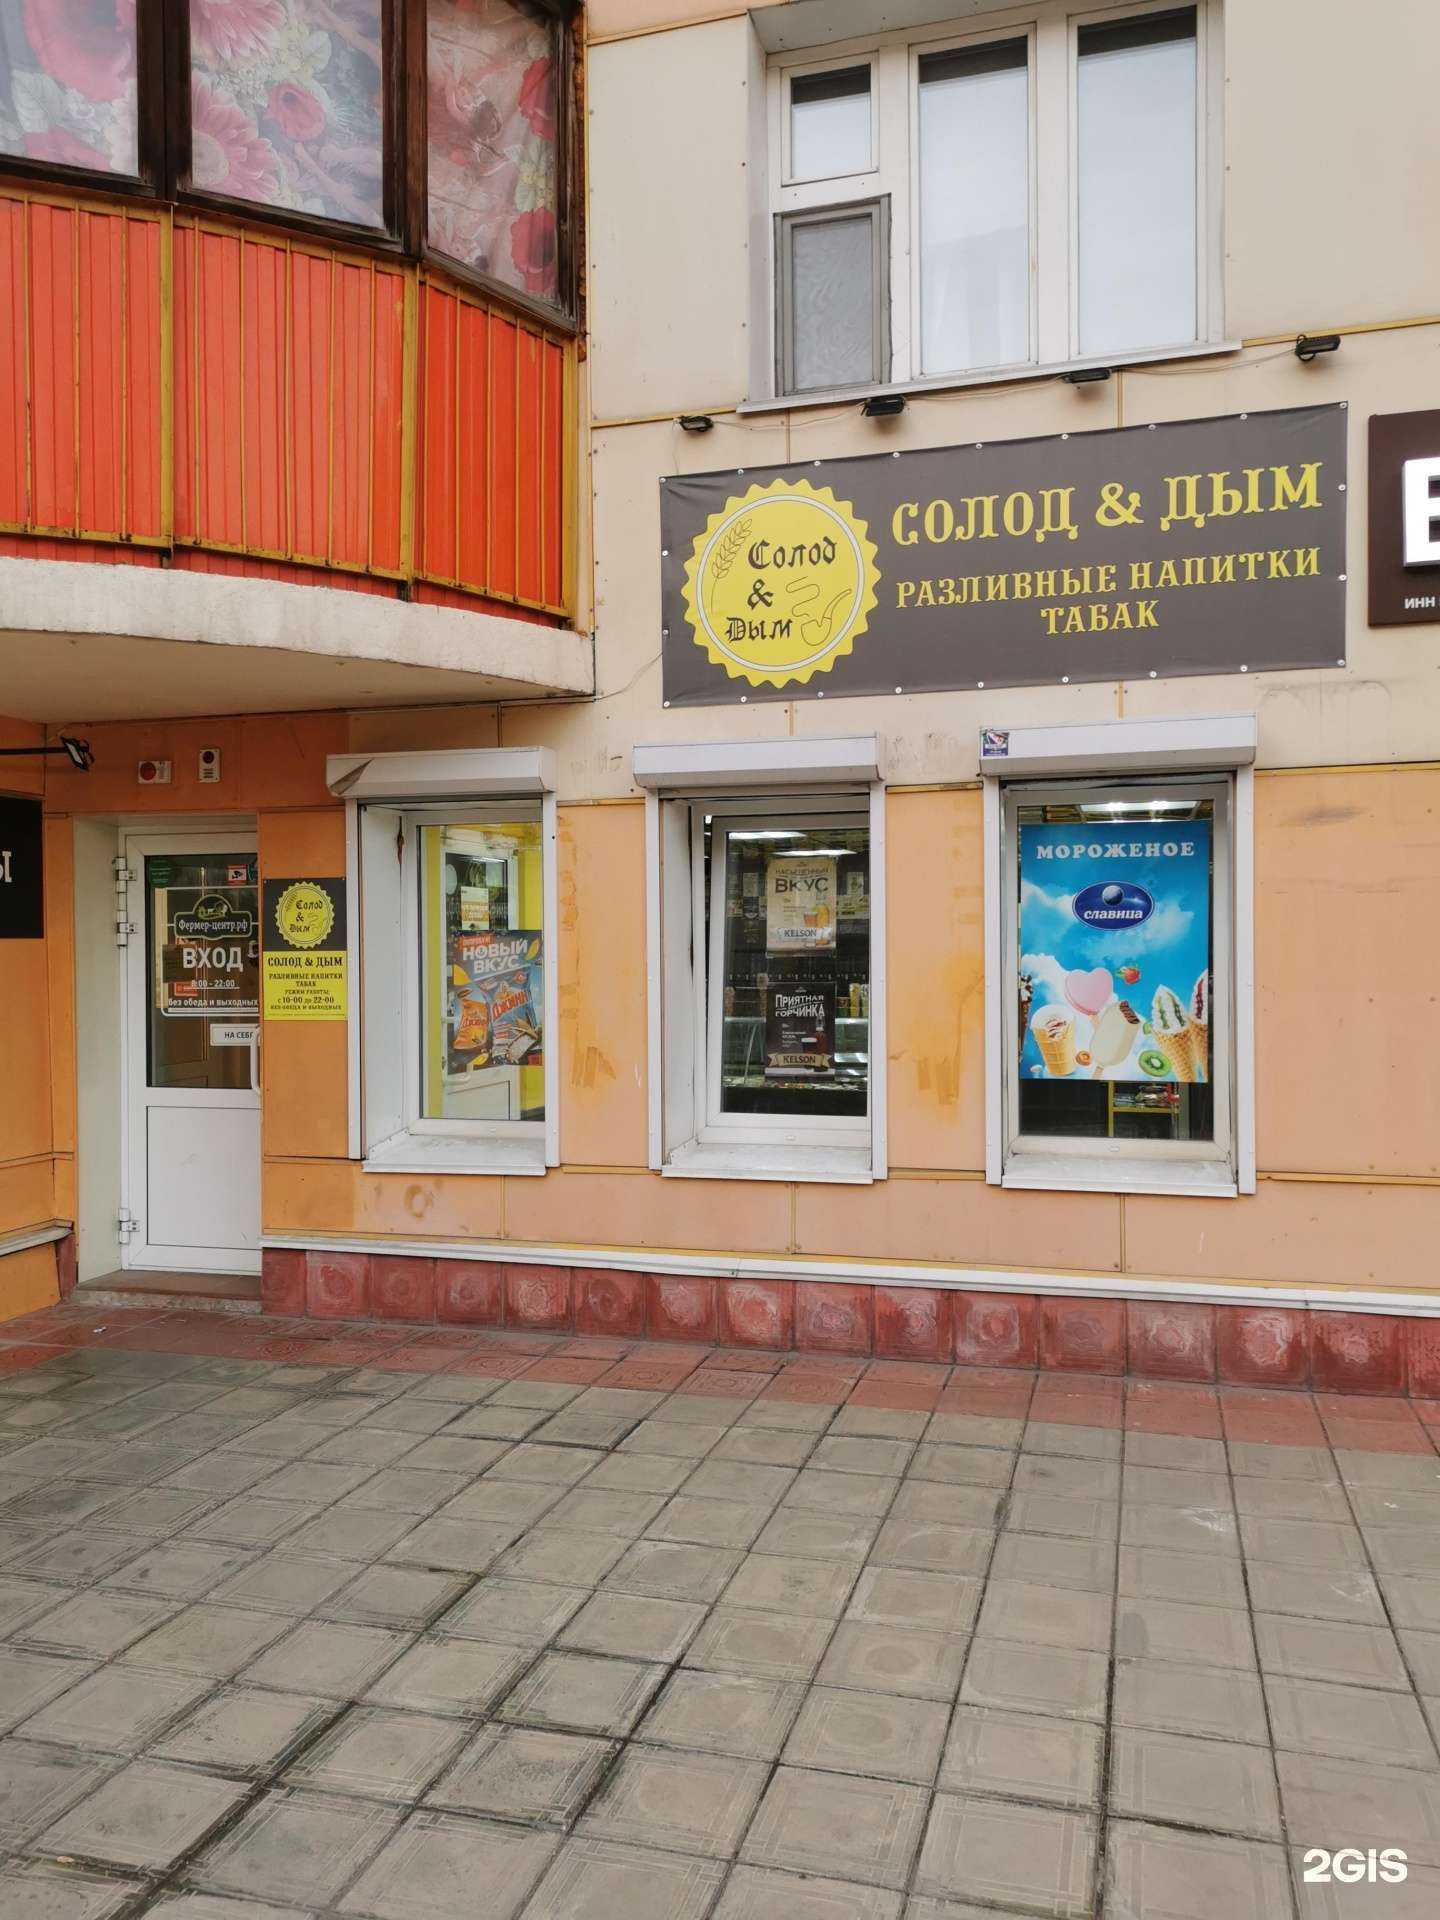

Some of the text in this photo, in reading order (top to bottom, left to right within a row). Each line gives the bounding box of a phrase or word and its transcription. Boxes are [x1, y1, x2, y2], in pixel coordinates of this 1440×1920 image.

[891, 461, 1322, 546] СОЛОД & ДЫМ
[748, 536, 837, 569] Солод
[896, 547, 1321, 609] РАЗЛИВНЫЕ НАПИТКИ
[747, 578, 774, 610] &
[1404, 597, 1436, 609] ИНН
[1040, 599, 1160, 635] ТАБАК
[725, 616, 793, 643] Дым
[1036, 842, 1195, 859] МОРОЖЕНОЕ
[775, 877, 829, 893] ВКУС
[295, 900, 323, 911] Солод
[295, 911, 304, 922] &
[1084, 909, 1143, 920] славица
[178, 919, 248, 932] Фермер-центр.рф
[784, 929, 817, 937] KELSON
[462, 938, 528, 961] НОВЫЙ
[183, 947, 244, 972] ВХОД
[268, 956, 343, 968] СОЛОД & ДЫМ
[473, 954, 521, 974] ВКУС
[168, 998, 182, 1006] без
[183, 998, 208, 1007] обеда
[775, 994, 825, 1007] ПРИЯТНАЯ
[775, 1004, 825, 1017] ГОРЧИНКА
[783, 1055, 816, 1063] KELSON
